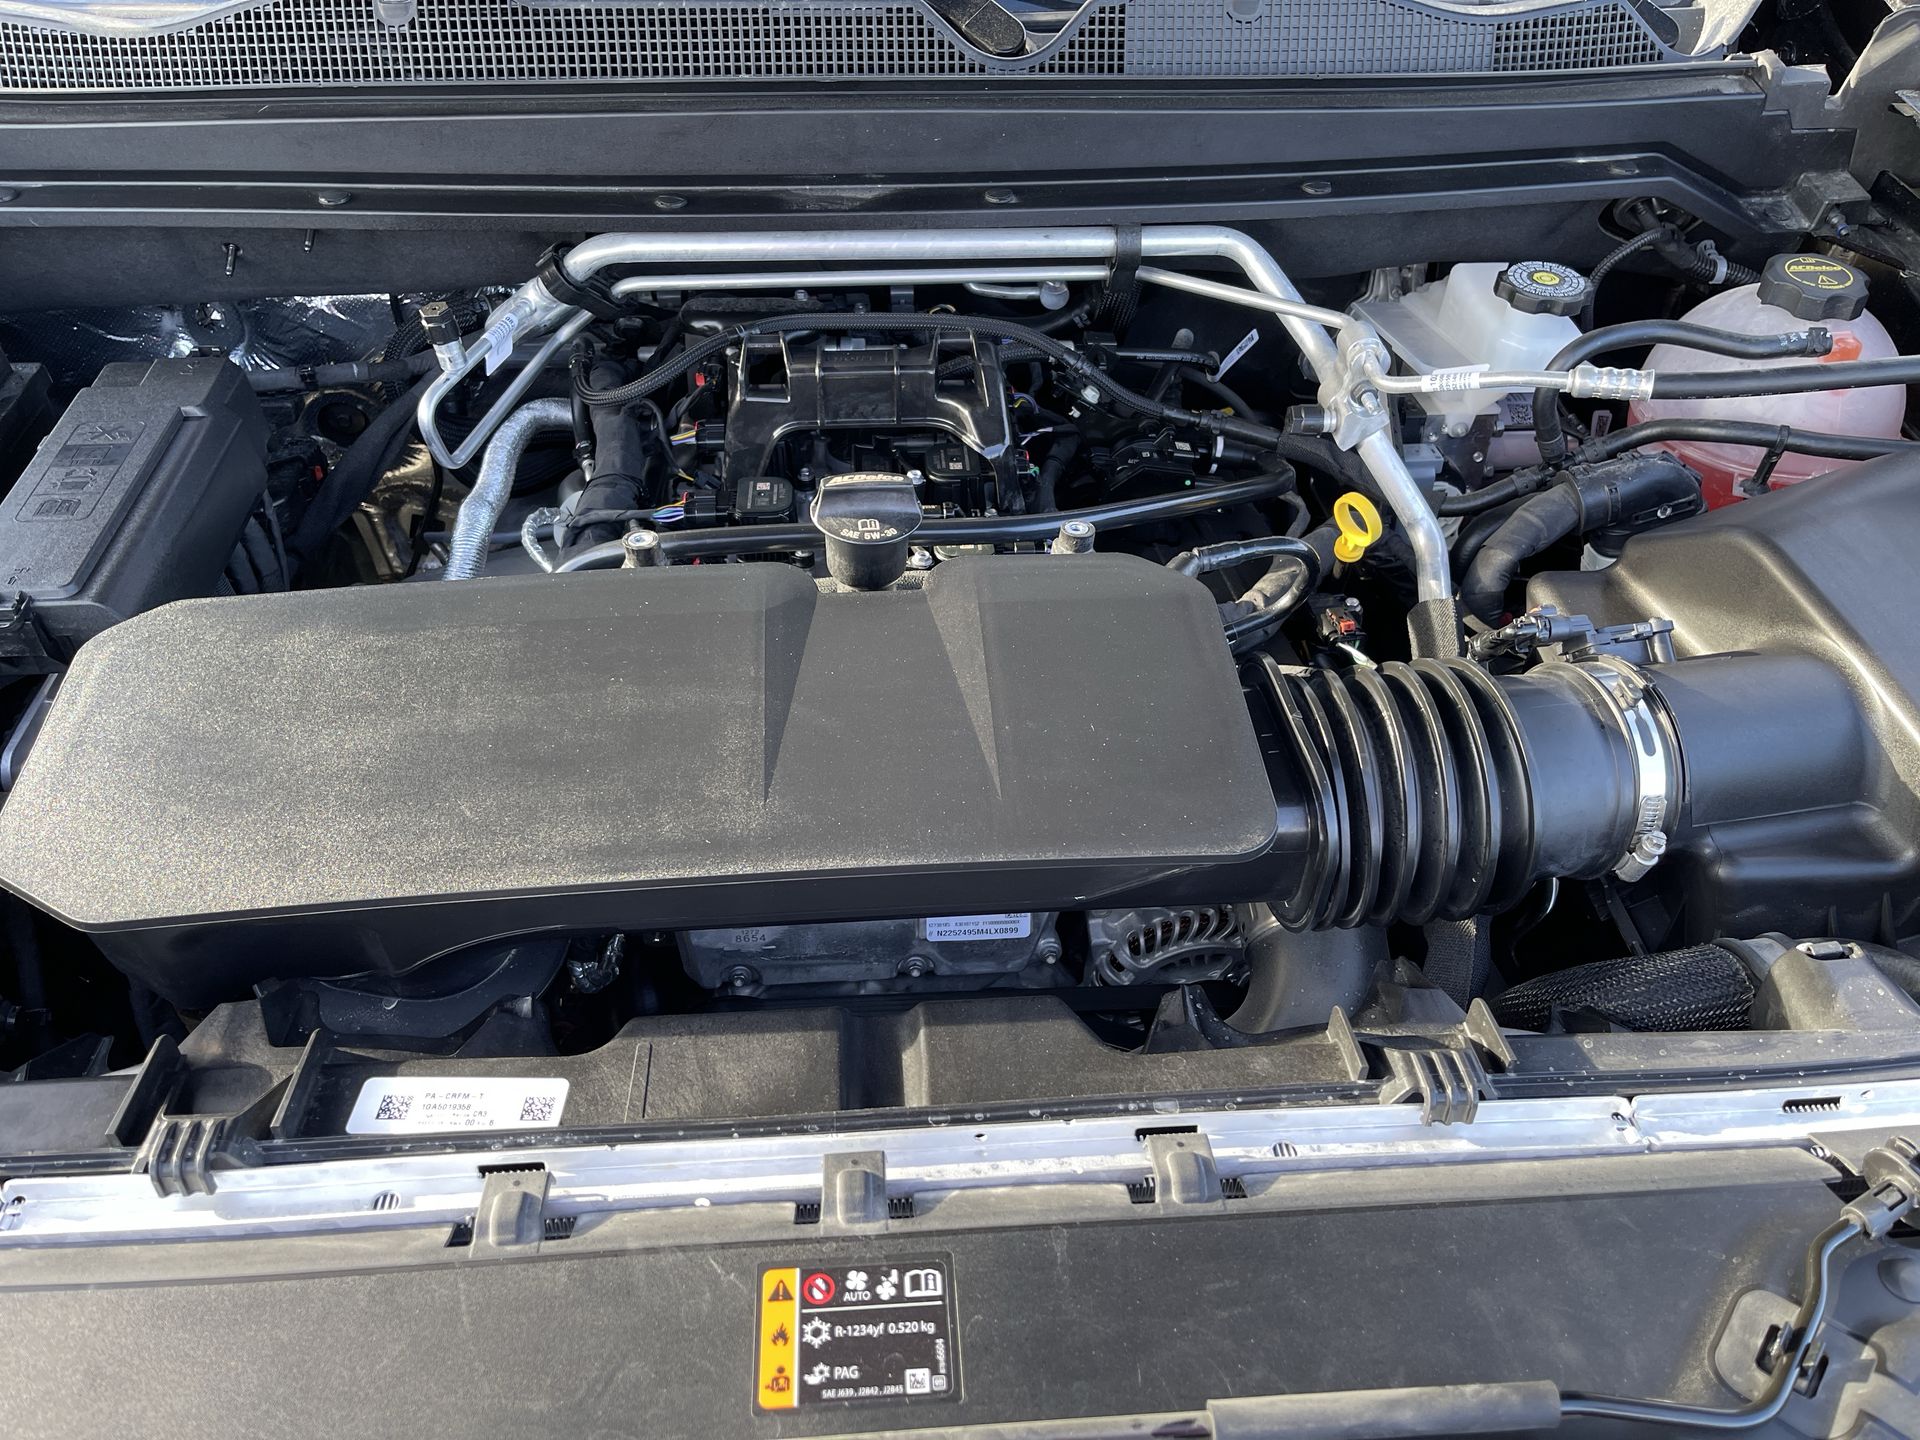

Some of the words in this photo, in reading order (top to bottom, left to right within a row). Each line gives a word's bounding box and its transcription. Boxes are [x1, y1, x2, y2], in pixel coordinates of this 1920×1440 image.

[1788, 264, 1842, 273] ACDelco
[827, 474, 905, 486] ACDelco
[840, 528, 861, 539] SAE
[863, 528, 898, 540] 5W-30
[735, 934, 766, 943] 8654
[844, 1292, 870, 1302] AUTO
[835, 1323, 884, 1337] R-1234yf
[888, 1322, 919, 1334] 0.520
[921, 1321, 935, 1334] kg
[834, 1366, 859, 1379] PAG
[822, 1388, 837, 1399] SAE
